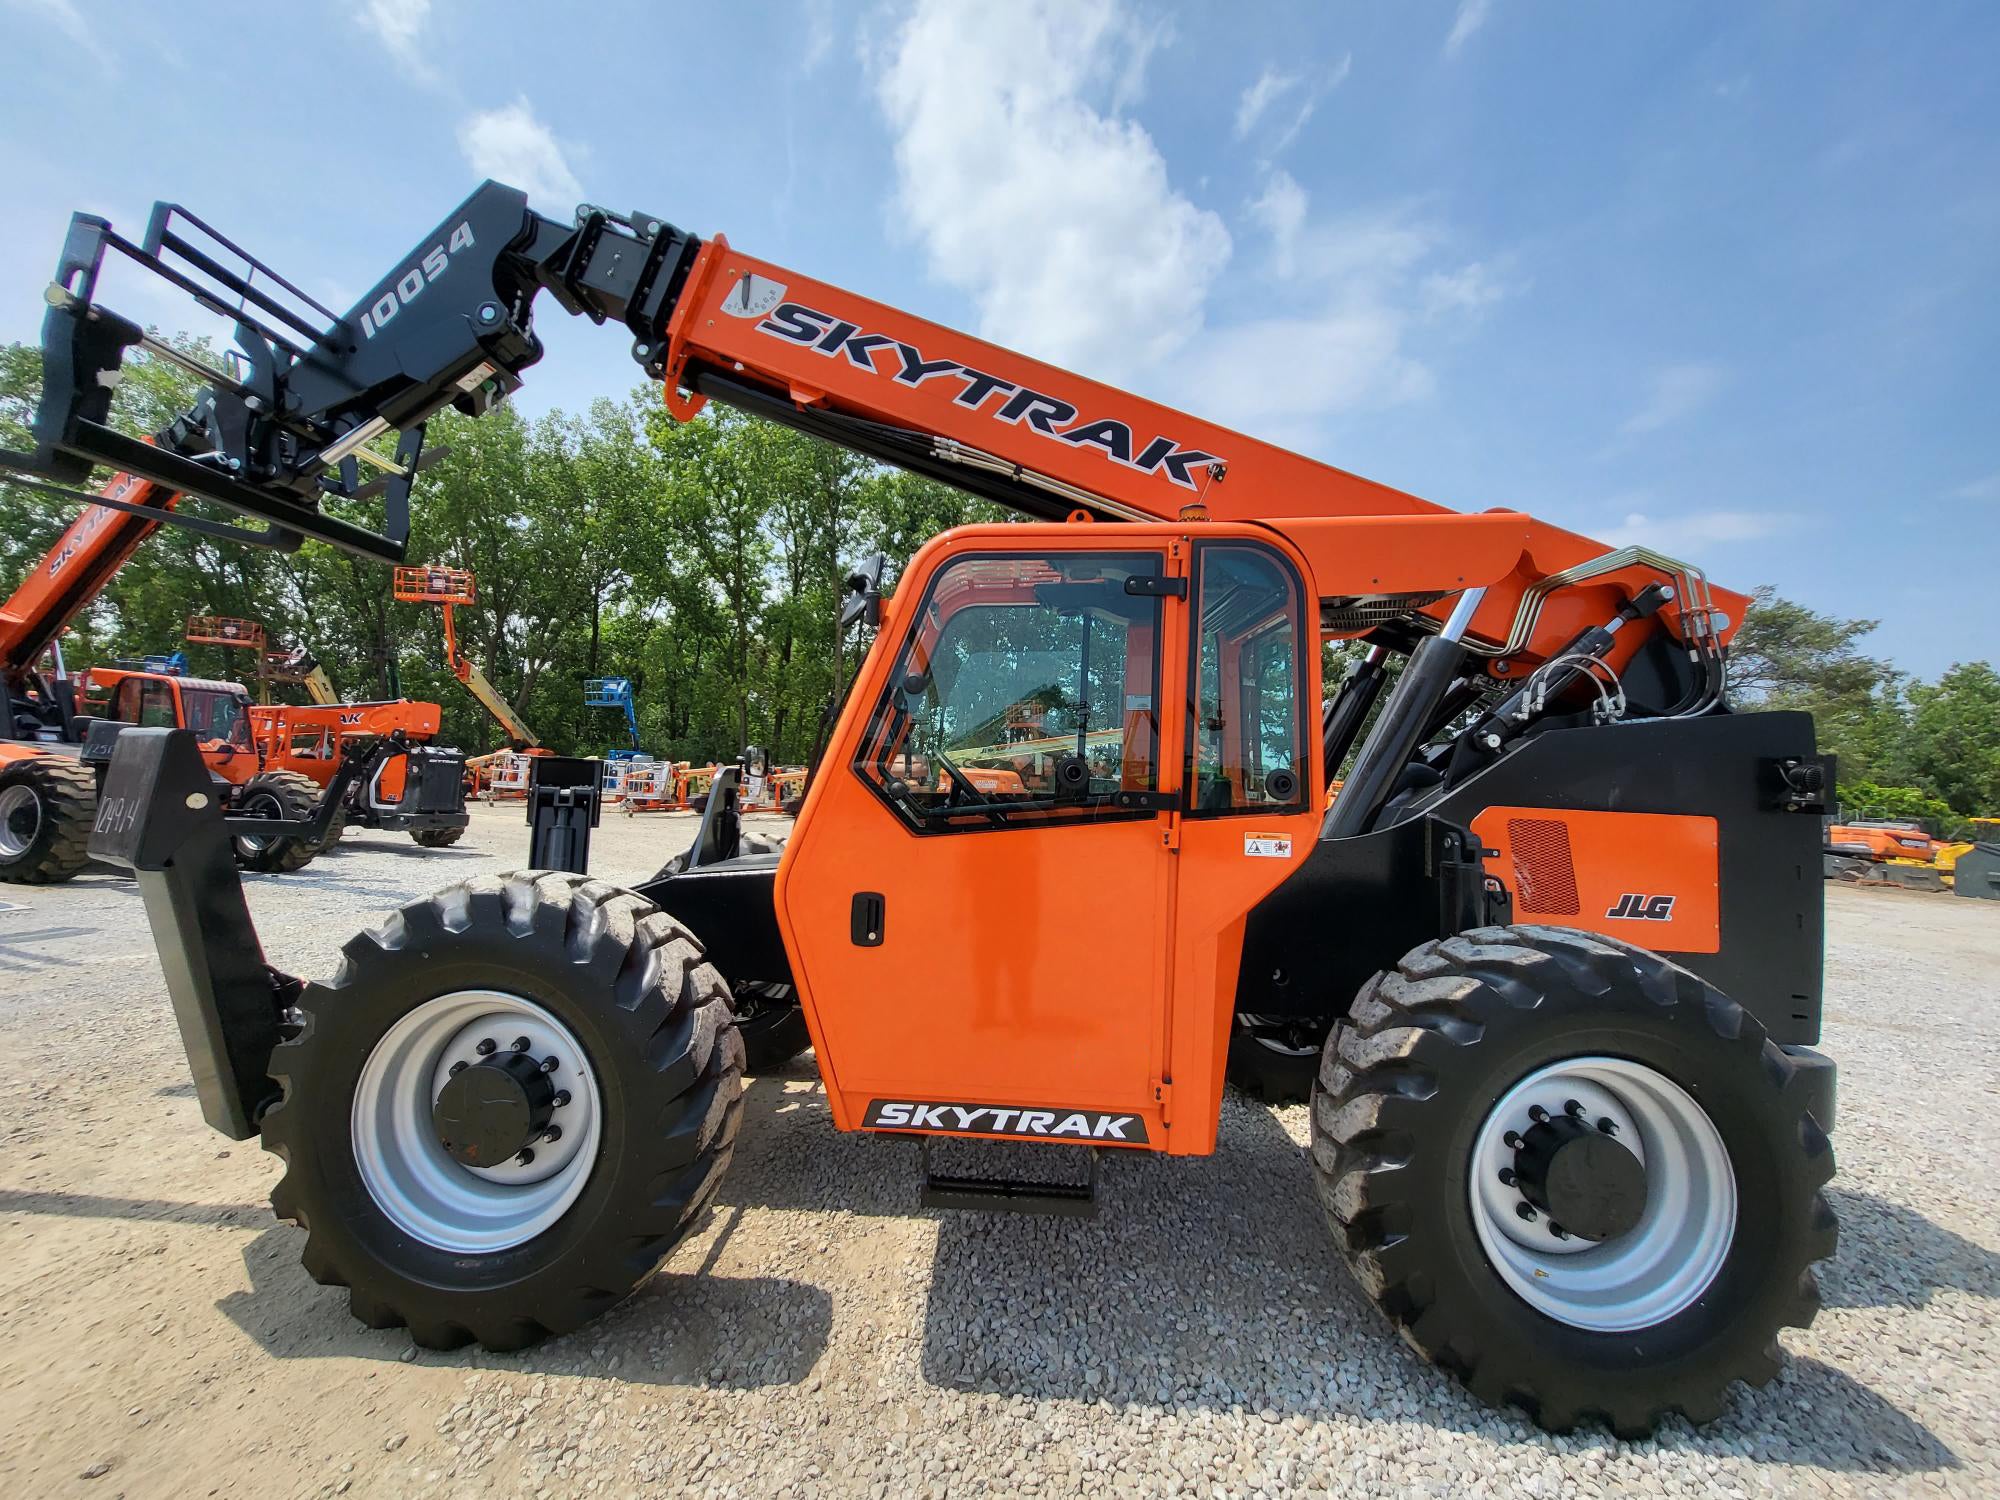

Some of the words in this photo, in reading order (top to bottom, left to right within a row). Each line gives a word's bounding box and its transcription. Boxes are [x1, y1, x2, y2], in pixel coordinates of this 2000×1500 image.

[360, 221, 475, 339] 10054
[754, 302, 1228, 492] SKYTRAK
[1605, 893, 1676, 921] JLG
[875, 1103, 1135, 1139] SKYTRAK
